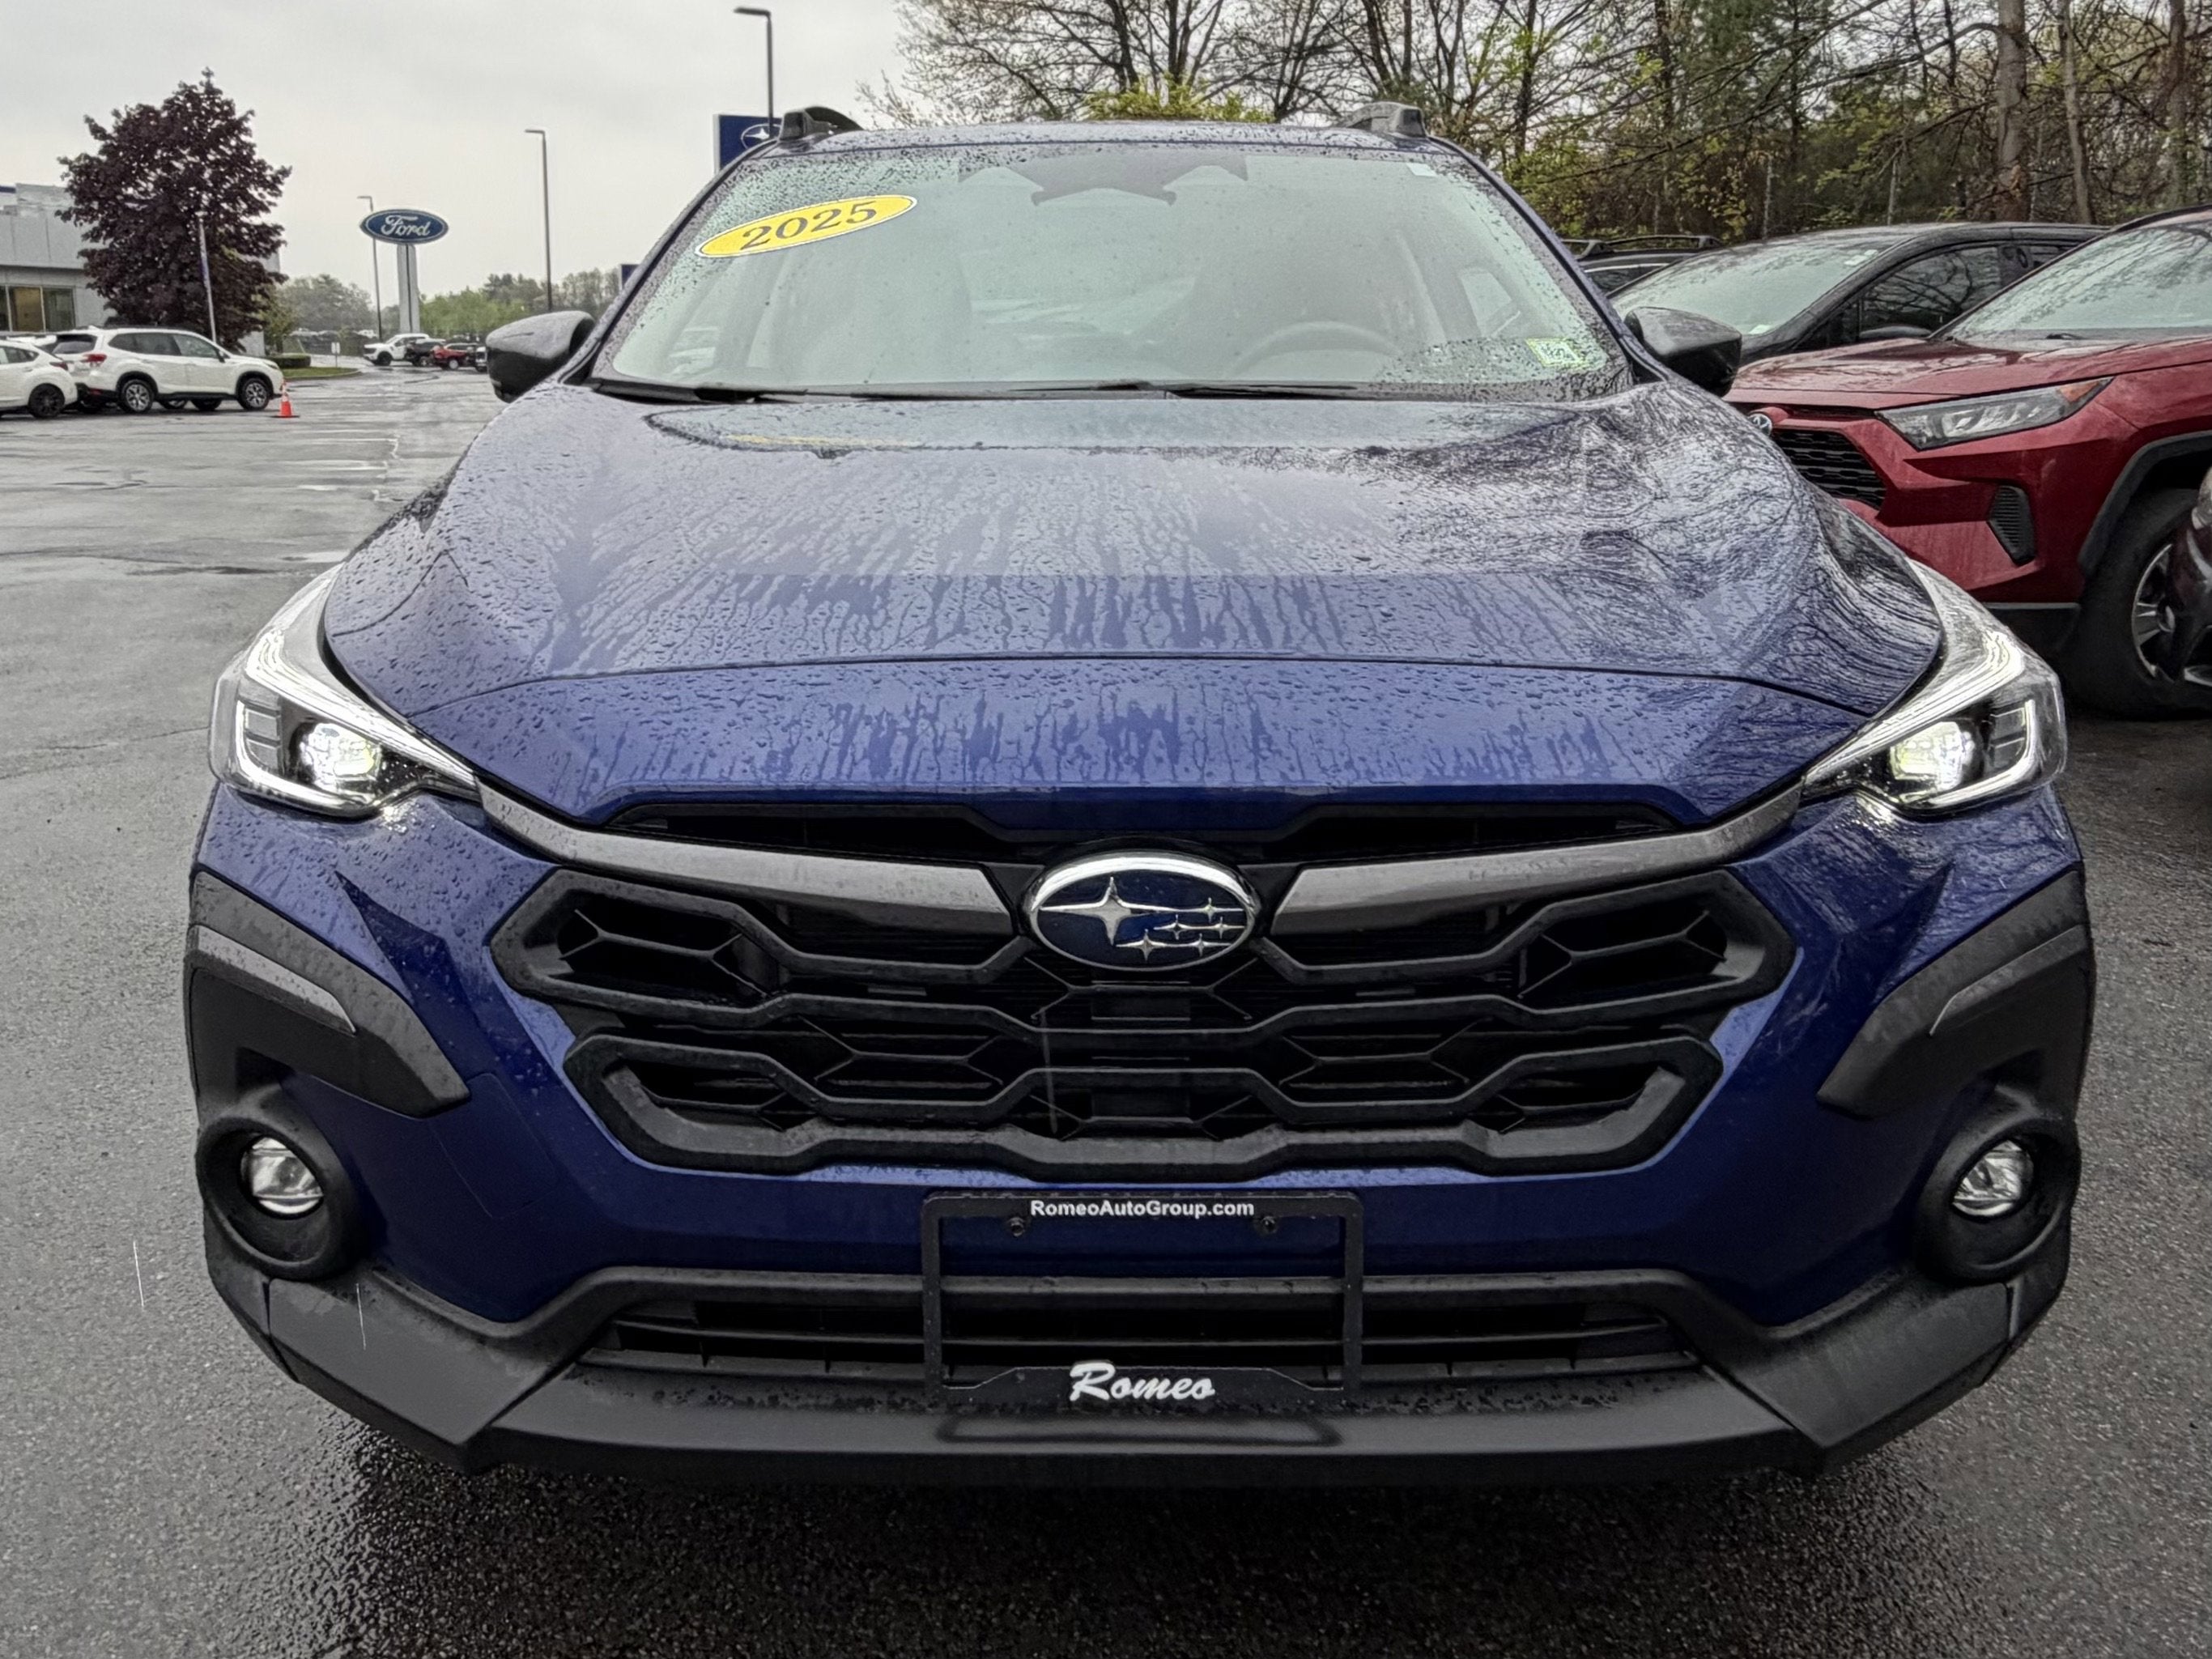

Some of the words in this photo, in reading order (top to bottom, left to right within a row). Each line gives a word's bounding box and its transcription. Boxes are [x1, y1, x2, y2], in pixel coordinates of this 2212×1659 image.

[381, 215, 431, 236] Ford
[740, 200, 877, 250] 2025
[1030, 1200, 1255, 1219] RomeoAutoGroup.com
[1070, 1360, 1216, 1402] Romeo
